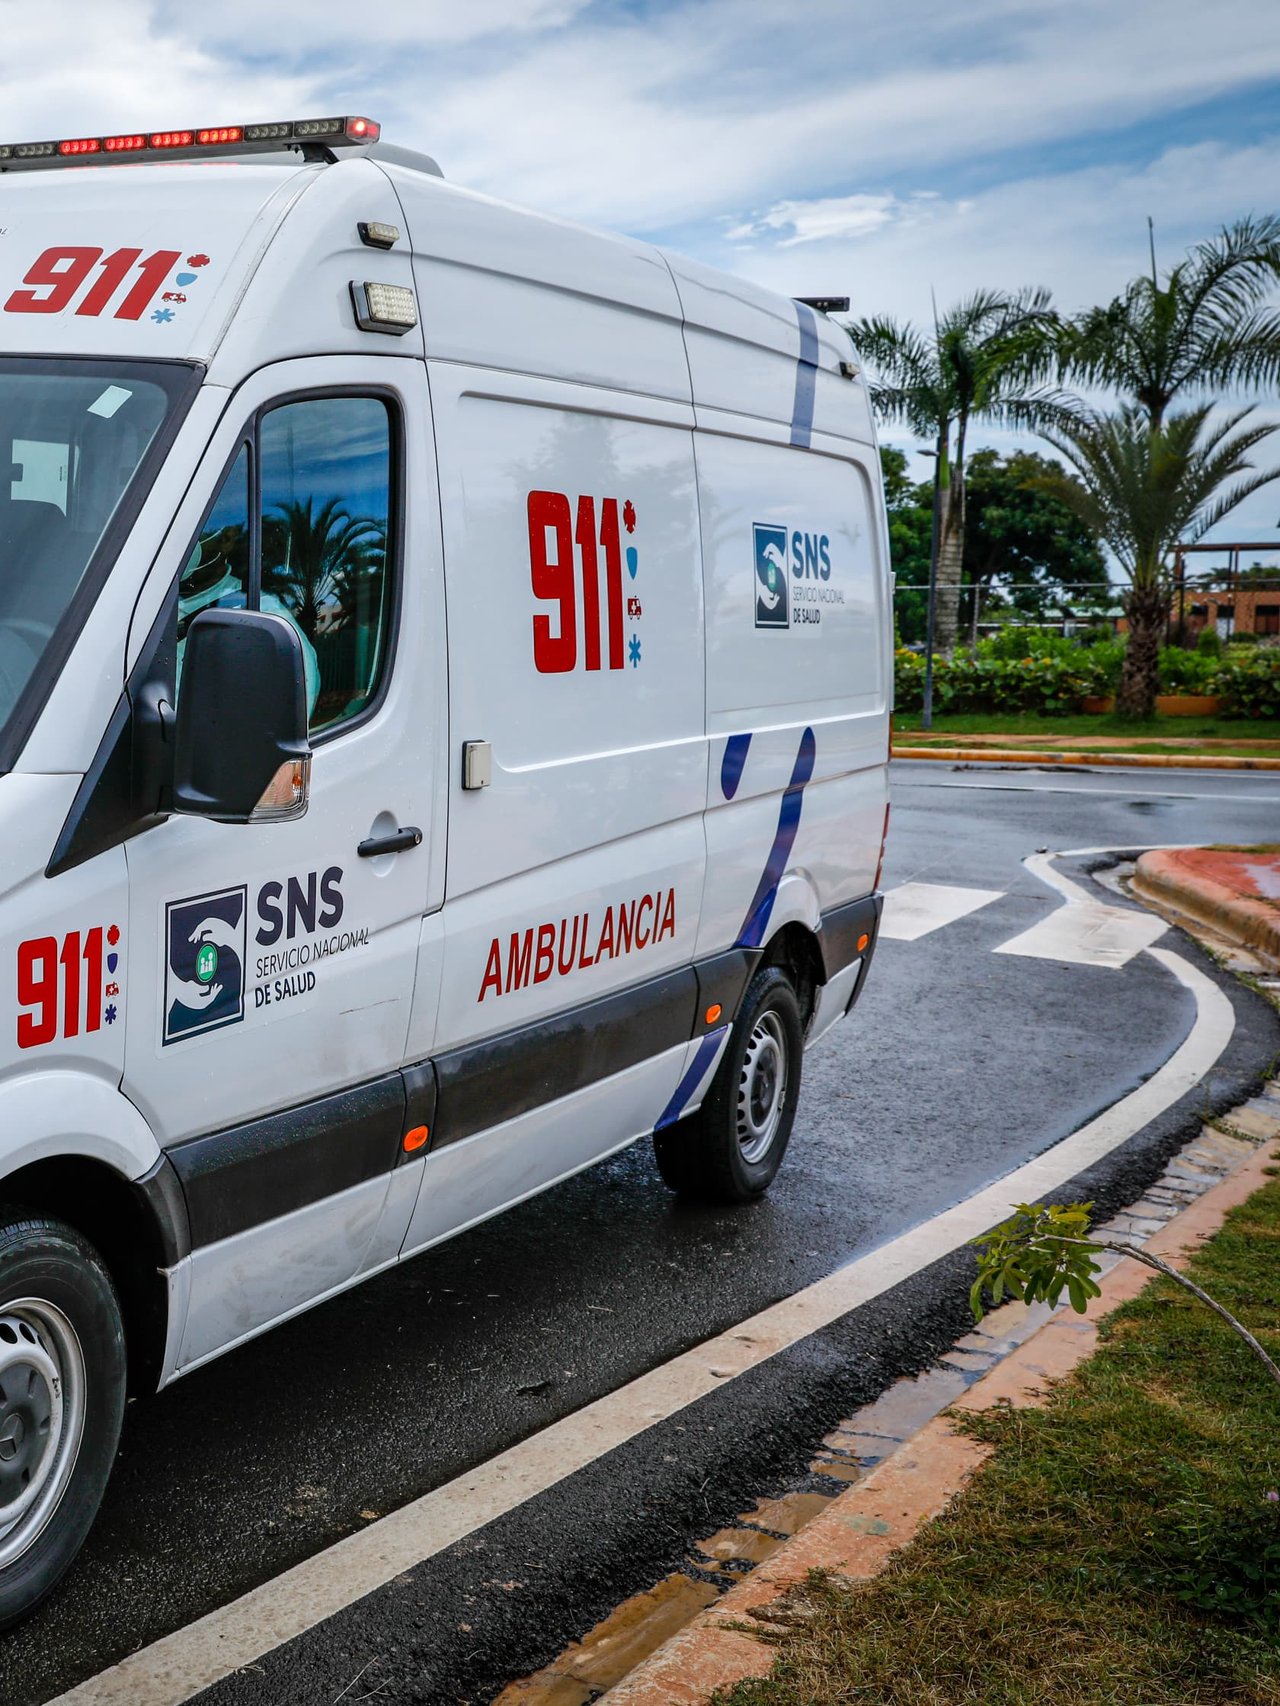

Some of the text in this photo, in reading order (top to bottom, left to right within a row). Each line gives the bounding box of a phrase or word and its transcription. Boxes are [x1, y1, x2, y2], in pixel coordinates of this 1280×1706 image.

[3, 246, 183, 321] 911
[527, 490, 625, 674] 911
[791, 530, 831, 581] SNS
[793, 608, 820, 623] DE SALUD
[255, 866, 344, 946] SNS
[255, 927, 370, 979] SERVICIO NACIONAL
[477, 887, 675, 1003] AMBULANCIA
[17, 926, 104, 1049] 911
[254, 971, 316, 1008] DE SALUD
